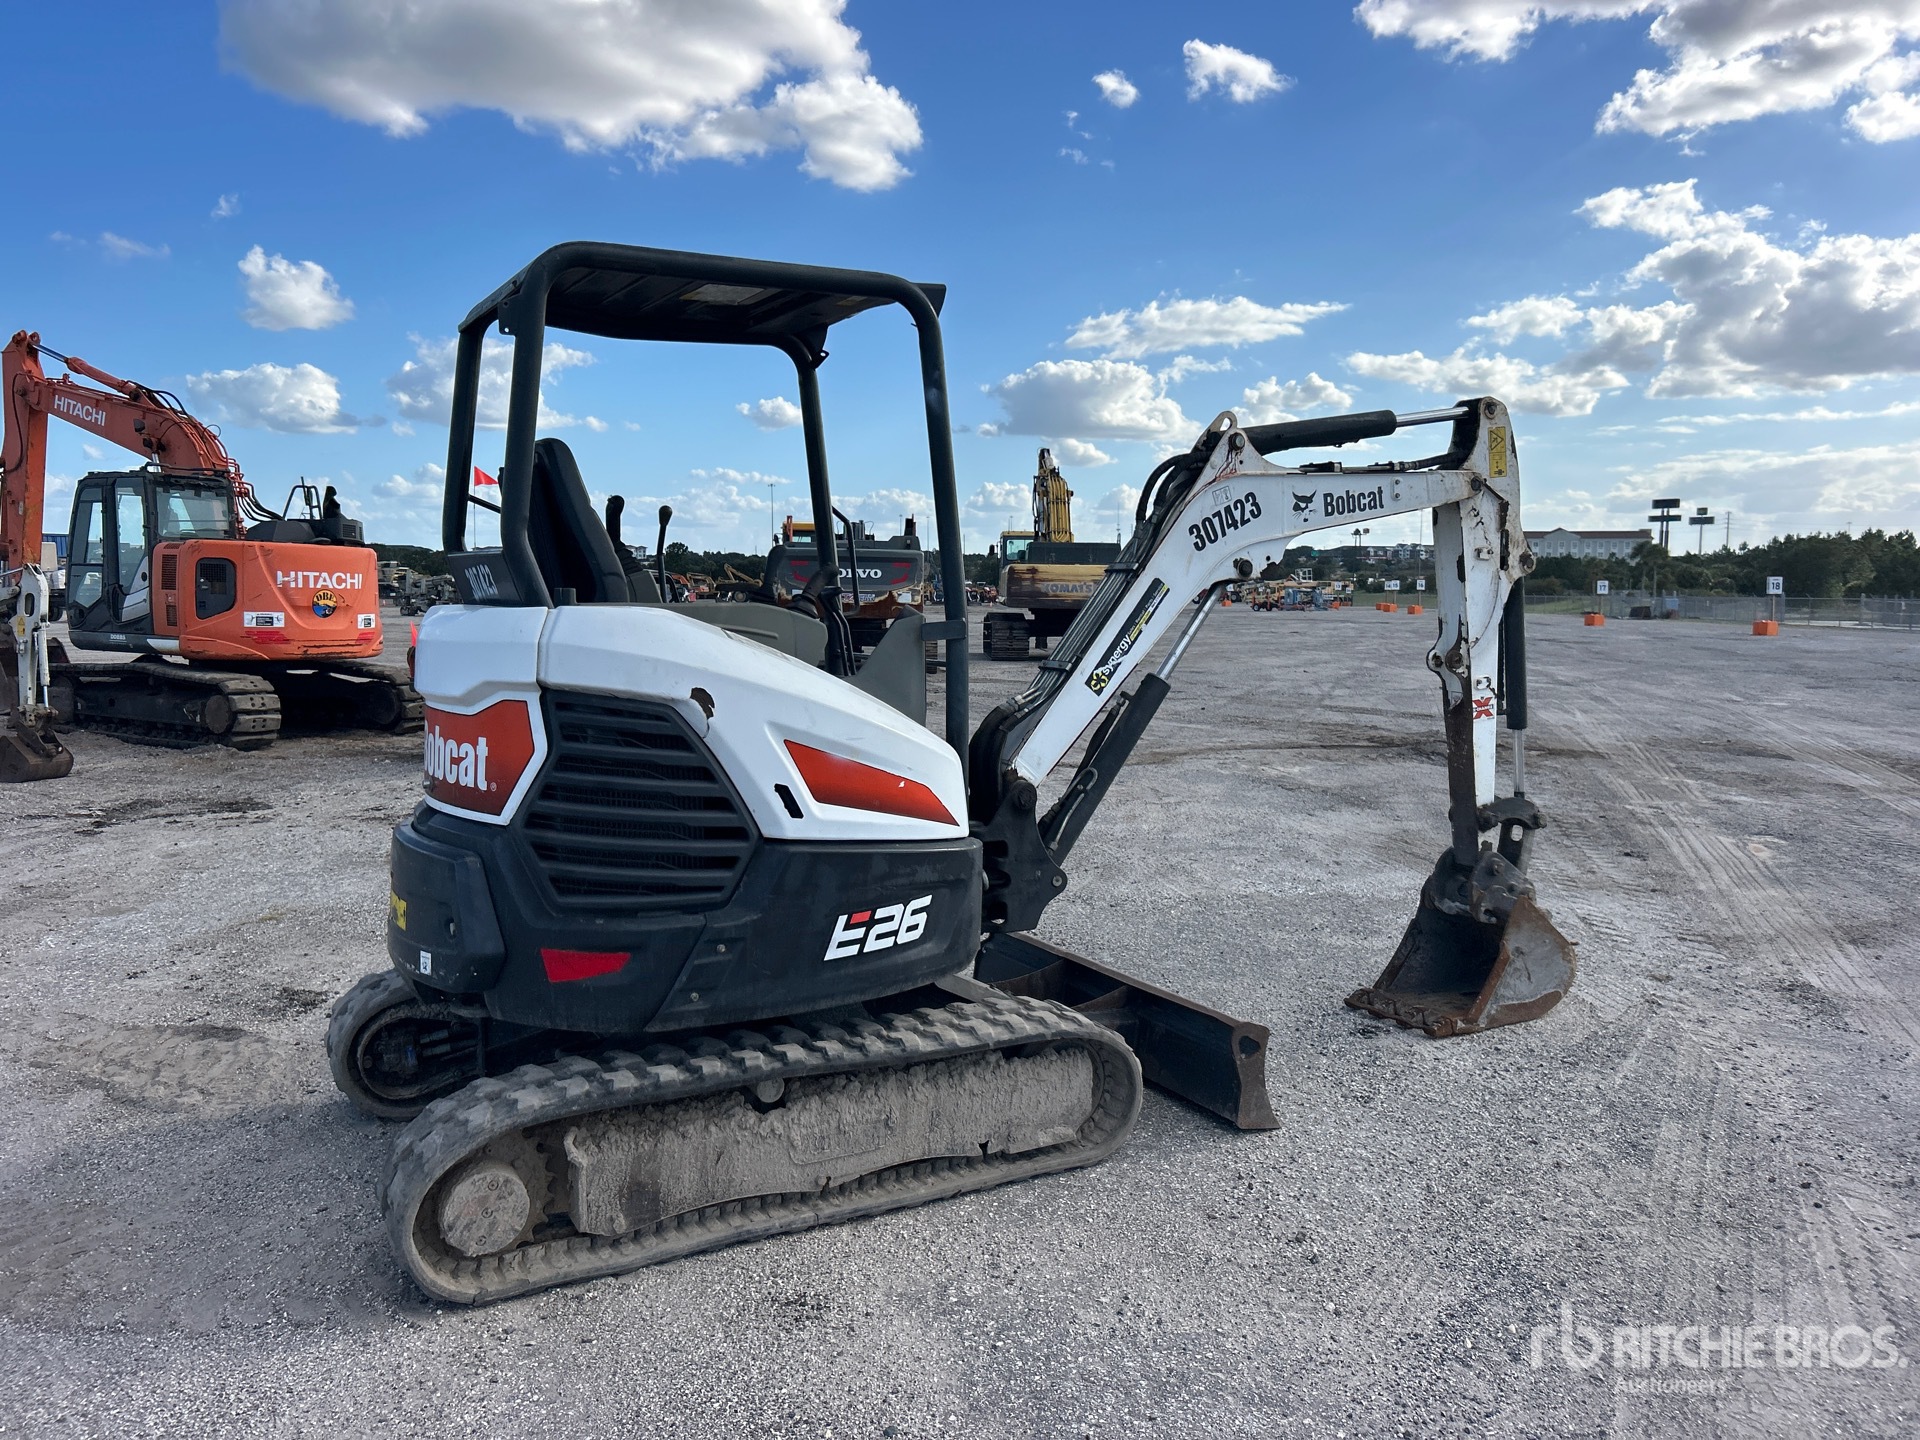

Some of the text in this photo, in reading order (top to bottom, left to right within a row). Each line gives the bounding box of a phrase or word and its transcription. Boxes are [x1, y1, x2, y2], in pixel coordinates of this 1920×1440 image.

[54, 396, 106, 426] HITACHI
[1323, 486, 1385, 518] Bobcat
[1188, 491, 1262, 551] 307423
[276, 570, 363, 590] HITACHI
[838, 568, 883, 579] OLVO
[1771, 581, 1781, 591] 18
[1102, 634, 1132, 675] synergy
[823, 894, 933, 962] E26
